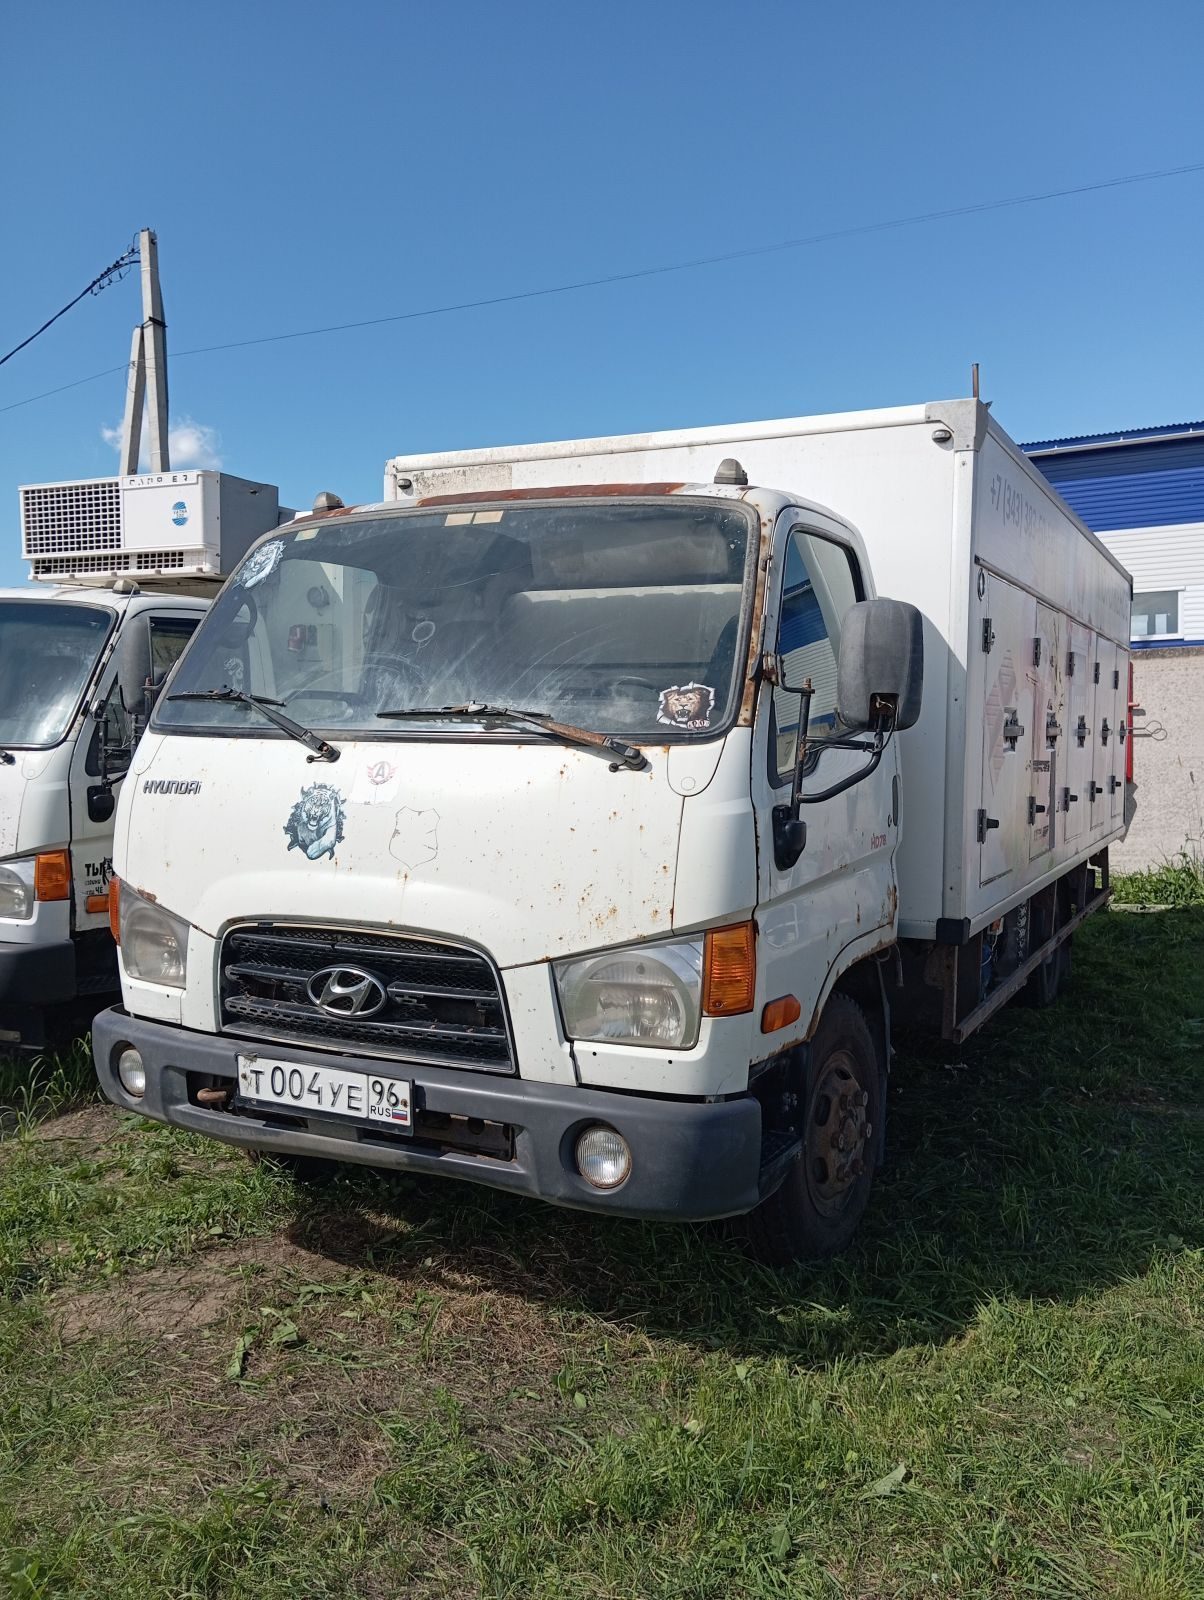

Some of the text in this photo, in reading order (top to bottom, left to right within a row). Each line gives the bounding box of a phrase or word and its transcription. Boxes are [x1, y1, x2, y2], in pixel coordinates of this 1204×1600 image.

[143, 779, 202, 795] HYUNDAI
[371, 1079, 400, 1108] 96
[370, 1105, 392, 1118] RUS
